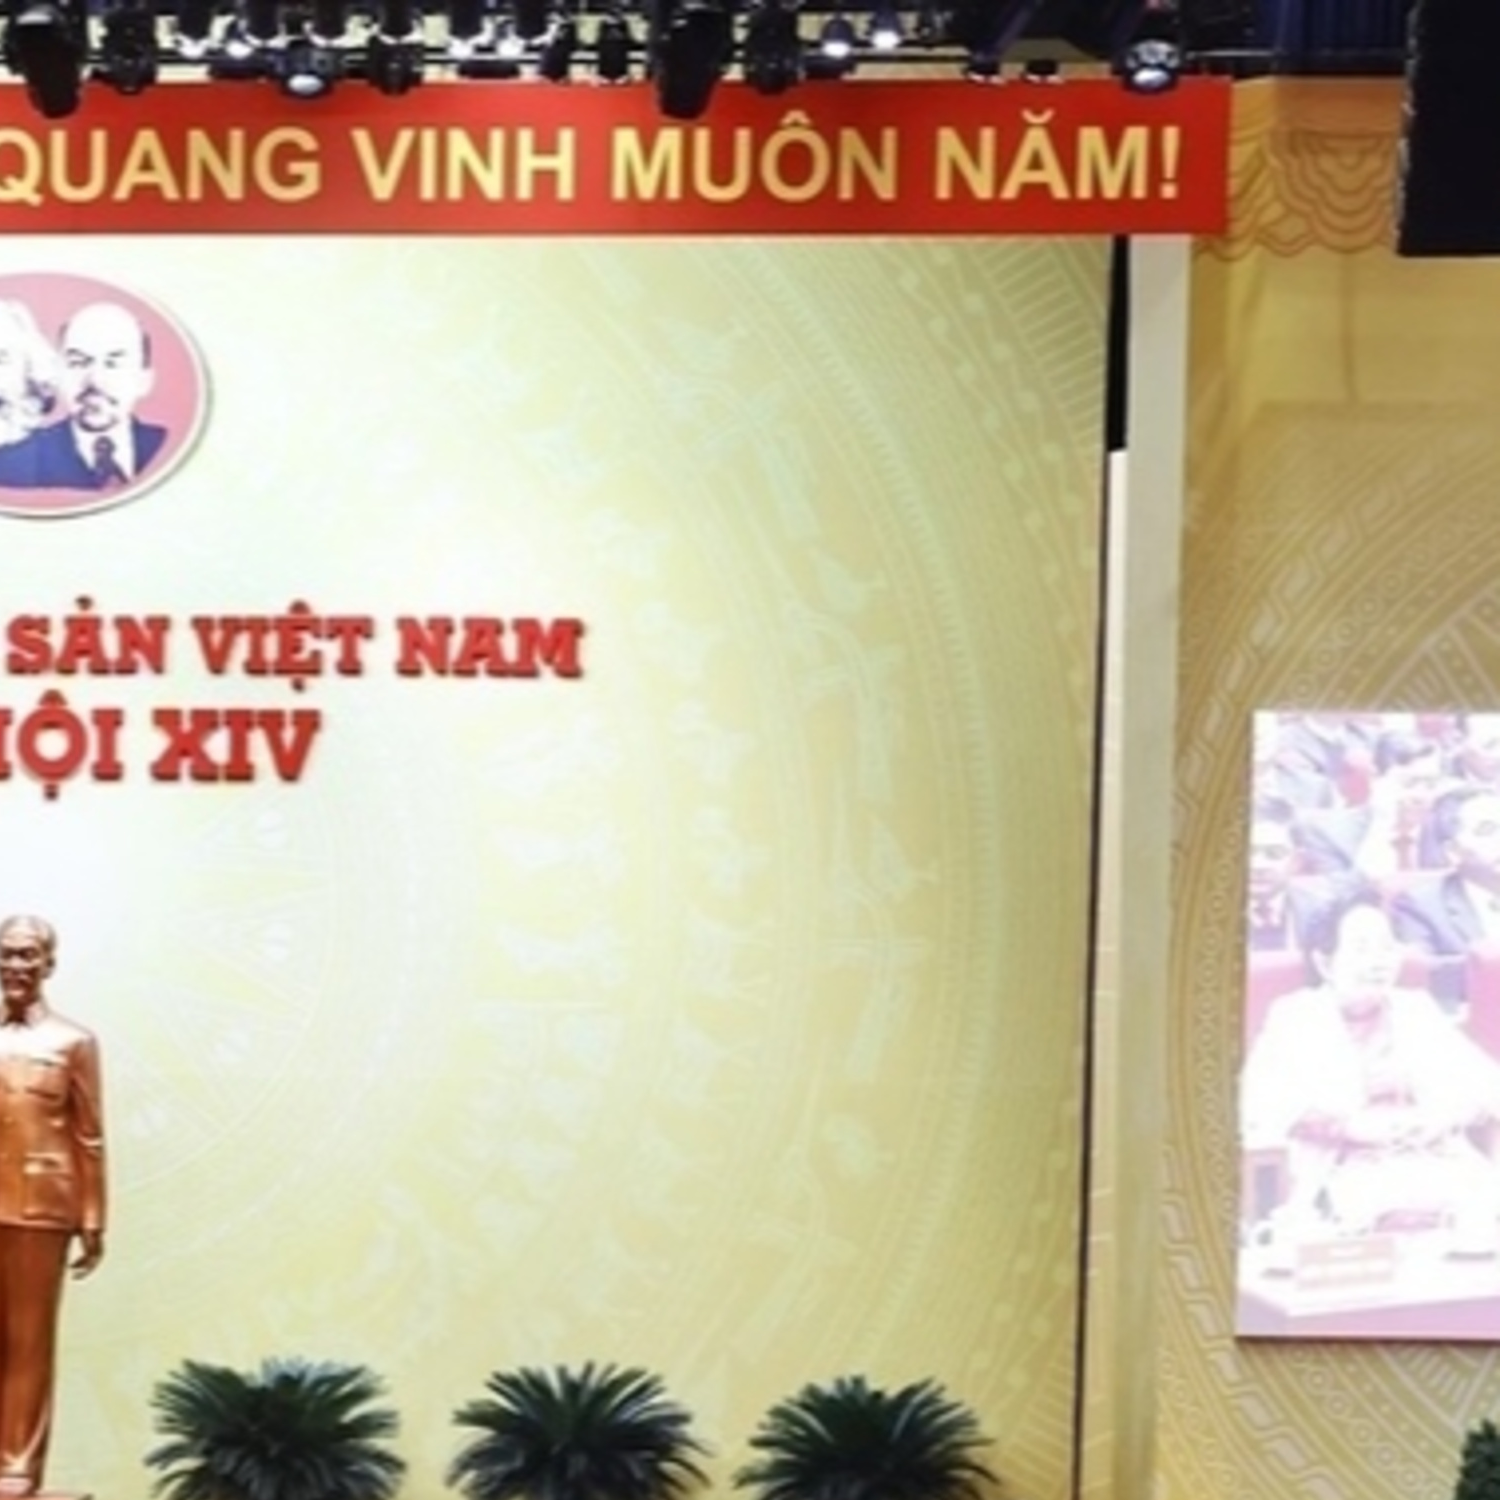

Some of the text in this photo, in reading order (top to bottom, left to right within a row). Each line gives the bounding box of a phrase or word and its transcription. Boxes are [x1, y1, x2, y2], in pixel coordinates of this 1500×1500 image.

[350, 126, 578, 202] VINH
[610, 110, 898, 202] MUÔN
[934, 109, 1181, 201] NĂM!
[6, 596, 170, 676] SẢN
[192, 600, 374, 693] VIỆT
[395, 616, 584, 678] NAM
[150, 708, 322, 782] XIV
